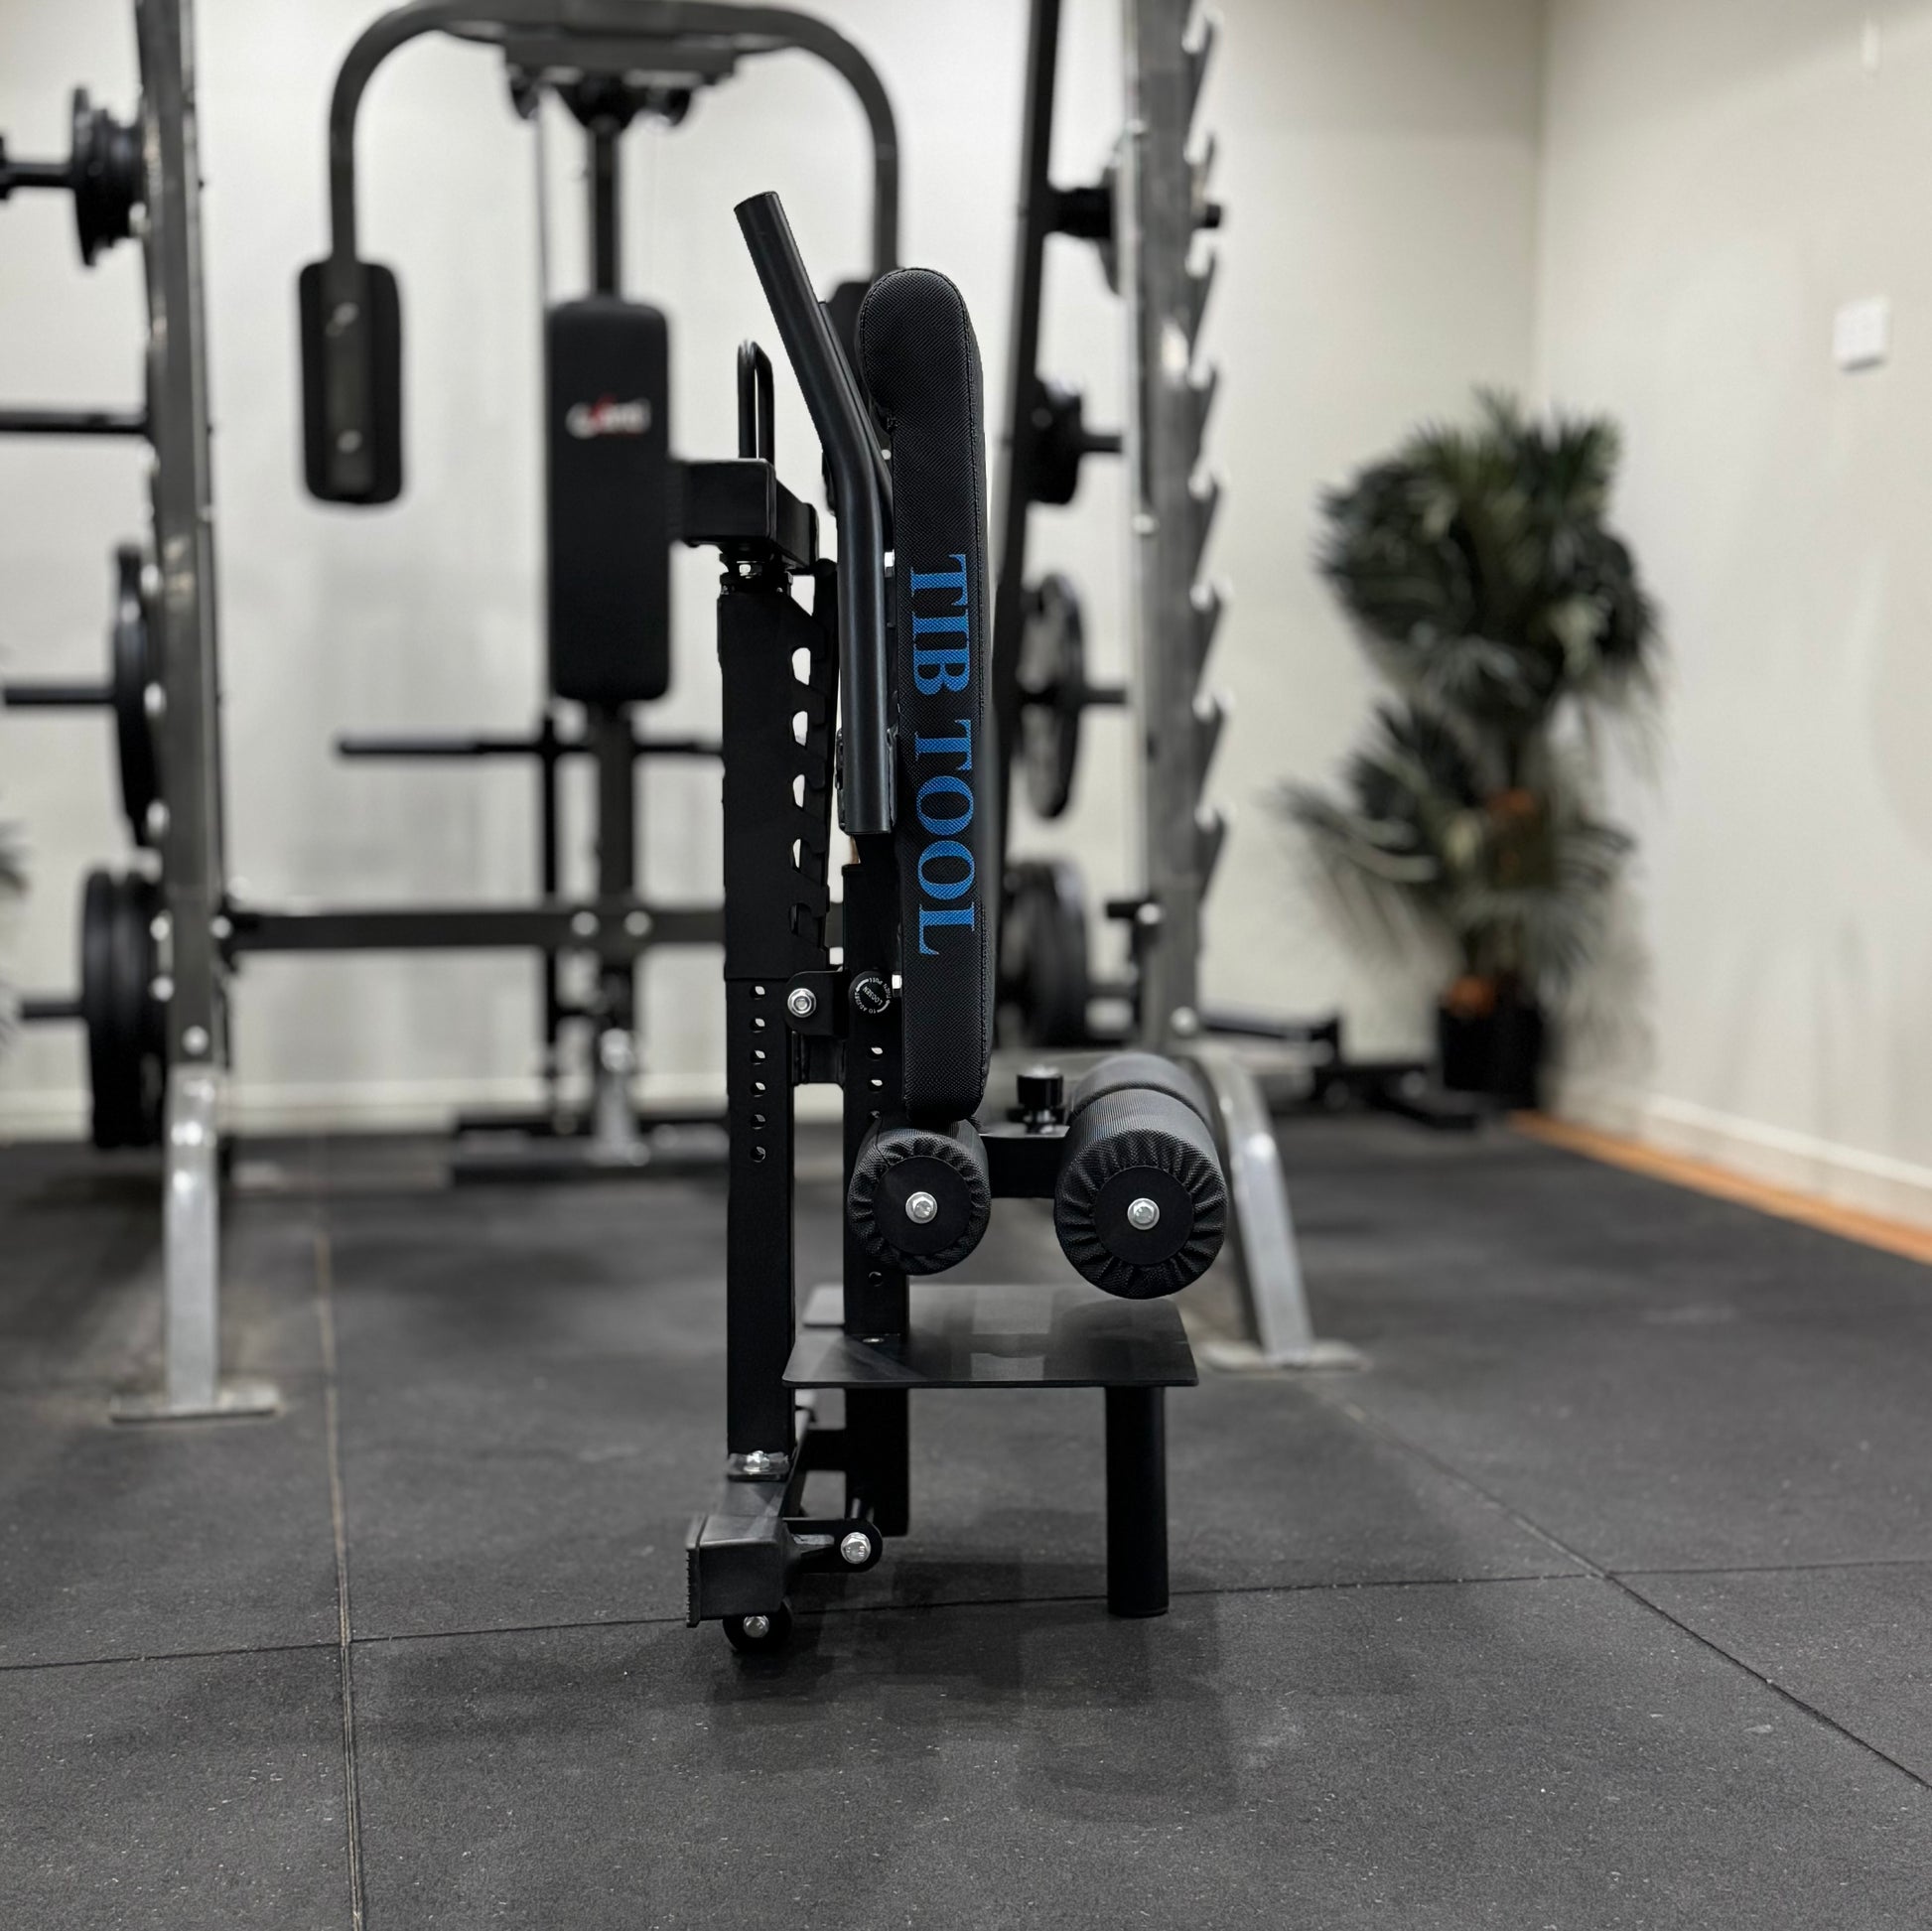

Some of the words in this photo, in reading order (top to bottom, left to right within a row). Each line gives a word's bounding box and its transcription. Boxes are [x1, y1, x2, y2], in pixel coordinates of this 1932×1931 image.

[909, 553, 970, 696] TIB
[913, 719, 976, 956] TOOL
[862, 986, 883, 1006] LOOSEN
